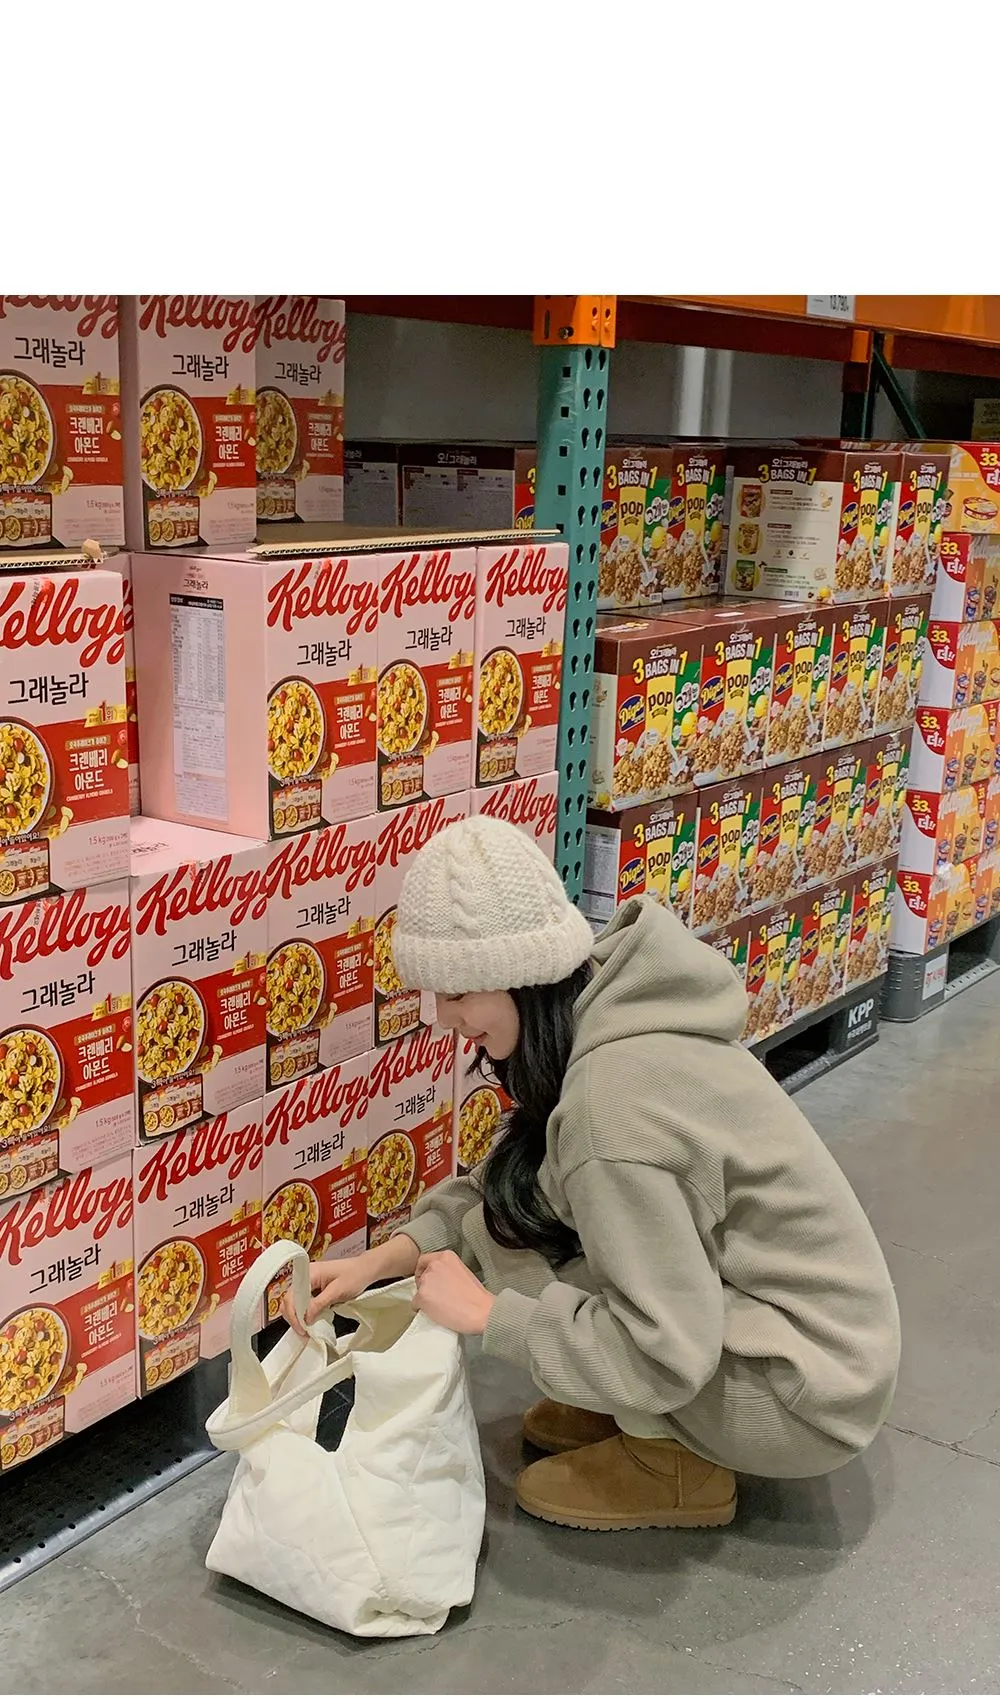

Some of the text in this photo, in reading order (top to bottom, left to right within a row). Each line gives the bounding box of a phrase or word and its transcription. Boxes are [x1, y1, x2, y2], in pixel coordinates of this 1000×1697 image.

[14, 337, 86, 368] 그래놀라
[172, 354, 230, 382] 그래놀라
[274, 362, 322, 386] 그래놀라
[74, 437, 101, 454] 아몬드
[218, 444, 240, 460] 아몬드
[607, 465, 618, 490] 3
[618, 471, 640, 486] BAGS
[650, 466, 658, 489] 1
[676, 464, 685, 487] 3
[685, 468, 702, 483] BAGS
[709, 464, 716, 485] 1
[758, 464, 769, 483] 3
[770, 469, 795, 481] BAGS
[807, 467, 817, 486] 1
[405, 625, 452, 651] 그래놀라
[505, 616, 546, 640] 그래놀라
[297, 639, 352, 667] 그래놀라
[714, 641, 725, 666] 3
[725, 644, 745, 661] BAGS
[755, 637, 763, 660] 1
[632, 657, 645, 684] 3
[645, 660, 669, 679] BAGS
[679, 650, 688, 676] 1
[8, 672, 89, 706] 그래놀라
[339, 721, 361, 740] 아몬드
[74, 770, 105, 792] 아몬드
[633, 823, 645, 848] 3
[645, 824, 666, 842] BAGS
[676, 813, 684, 836] 1
[296, 896, 351, 928] 그래놀라
[172, 930, 237, 966] 그래놀라
[21, 971, 95, 1013] 그래놀라
[339, 970, 359, 989] 아몬드
[224, 1010, 248, 1030] 아몬드
[848, 998, 874, 1028] KPP
[83, 1057, 110, 1080] 아몬드
[394, 1085, 436, 1121] 그래놀라
[293, 1131, 345, 1170] 그래놀라
[426, 1151, 442, 1168] 아몬드
[173, 1183, 235, 1227] 그래놀라
[333, 1200, 352, 1219] 아몬드
[29, 1243, 101, 1294] 그래놀라
[222, 1255, 244, 1278] 아몬드
[89, 1320, 114, 1346] 아몬드
